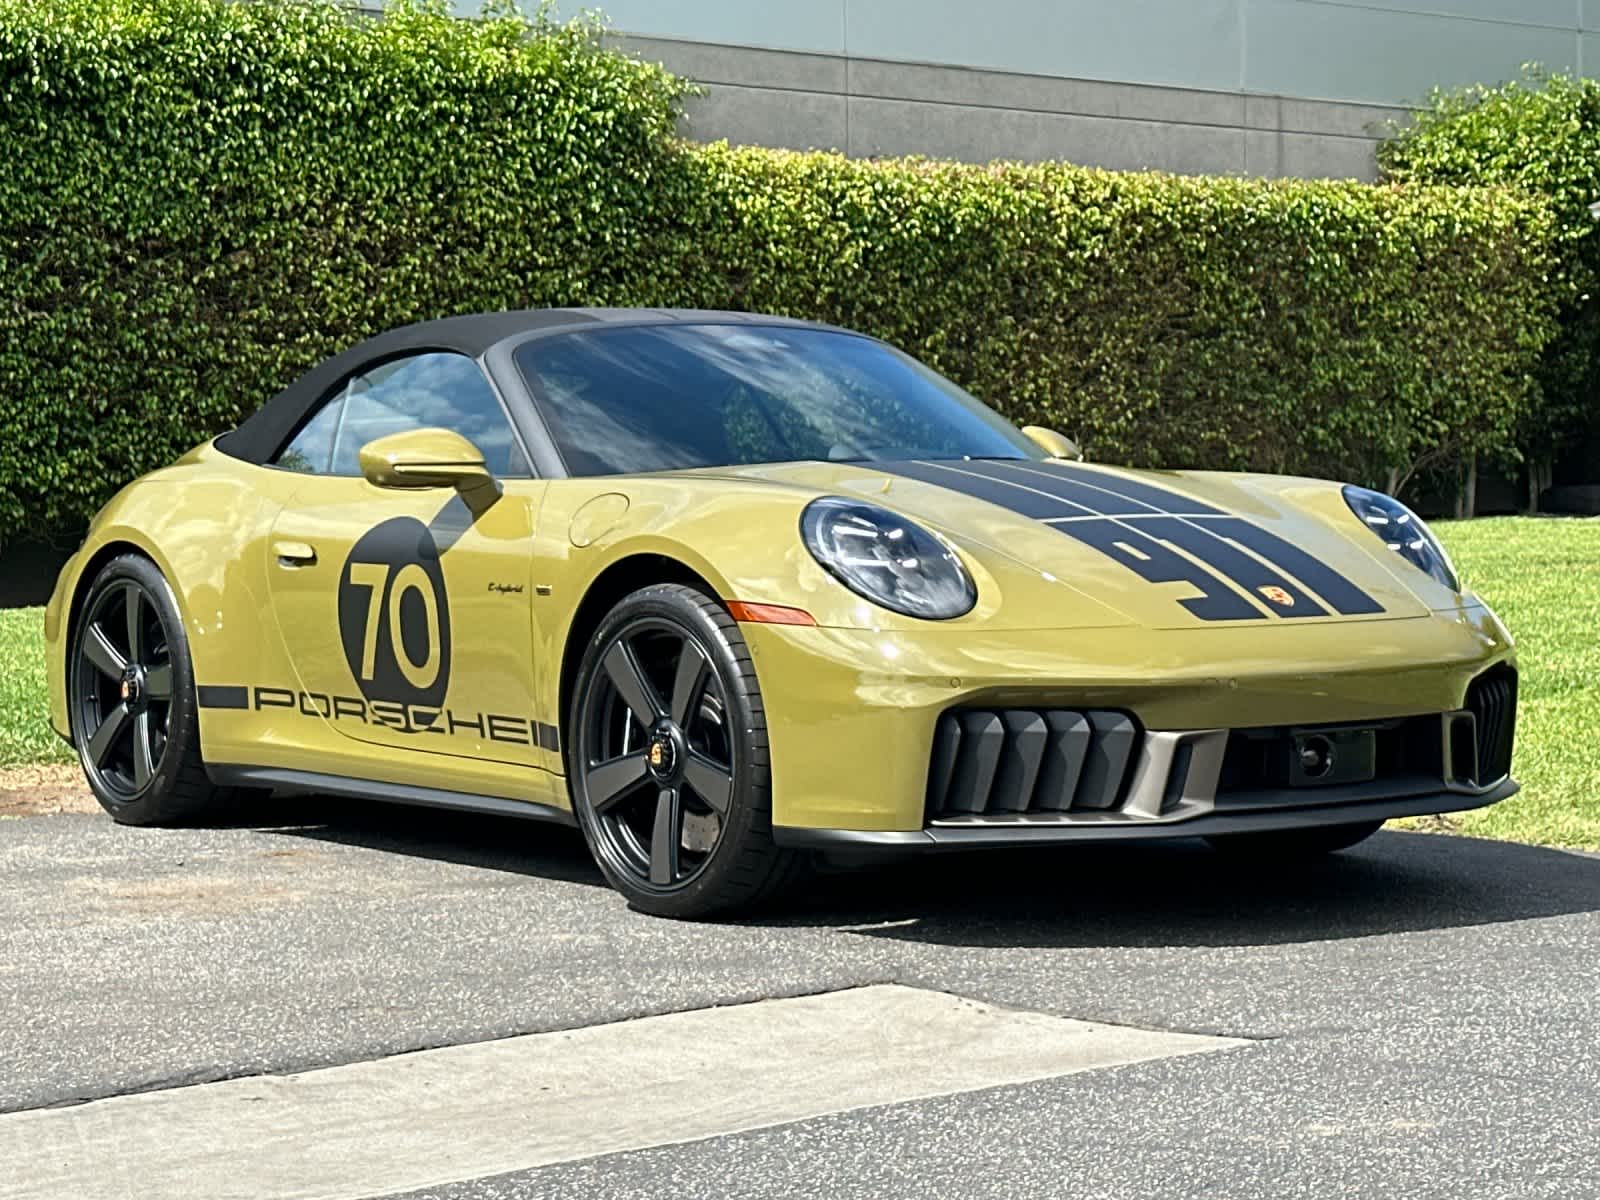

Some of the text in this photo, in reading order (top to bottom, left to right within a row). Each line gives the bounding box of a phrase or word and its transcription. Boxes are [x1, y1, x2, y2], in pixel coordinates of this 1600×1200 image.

[1043, 516, 1386, 621] 911
[350, 562, 441, 689] 70
[254, 687, 530, 745] PORSCHE
